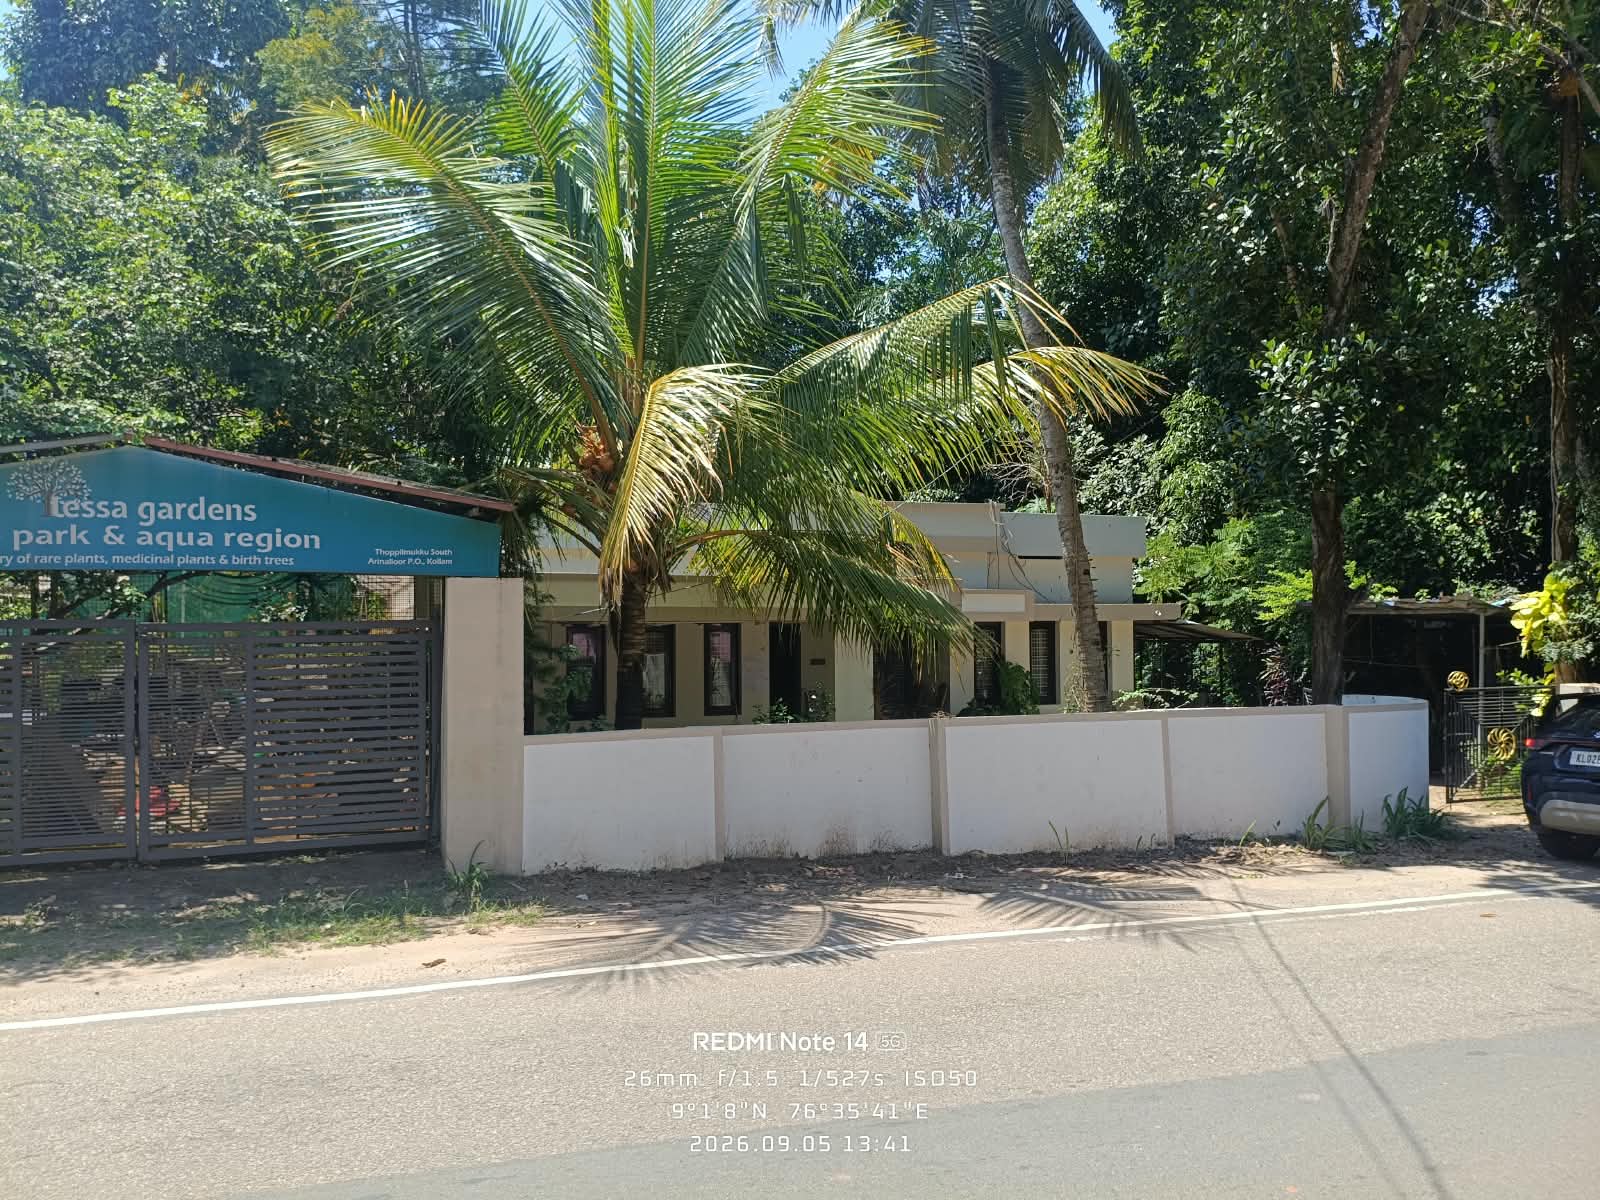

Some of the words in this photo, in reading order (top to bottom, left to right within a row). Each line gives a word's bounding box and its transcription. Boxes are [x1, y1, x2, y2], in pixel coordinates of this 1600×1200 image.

[50, 495, 128, 519] tessa
[137, 497, 257, 527] gardens
[13, 524, 90, 551] park
[104, 525, 125, 546] &
[136, 530, 214, 552] aqua
[224, 528, 321, 553] region
[430, 548, 453, 556] South
[16, 553, 32, 564] of
[34, 555, 61, 564] rare
[64, 553, 108, 567] plants,
[111, 553, 174, 565] medicinal
[176, 554, 217, 567] plants
[219, 554, 229, 565] &
[232, 555, 261, 566] birth
[264, 556, 295, 566] trees
[426, 558, 453, 566] Kollam
